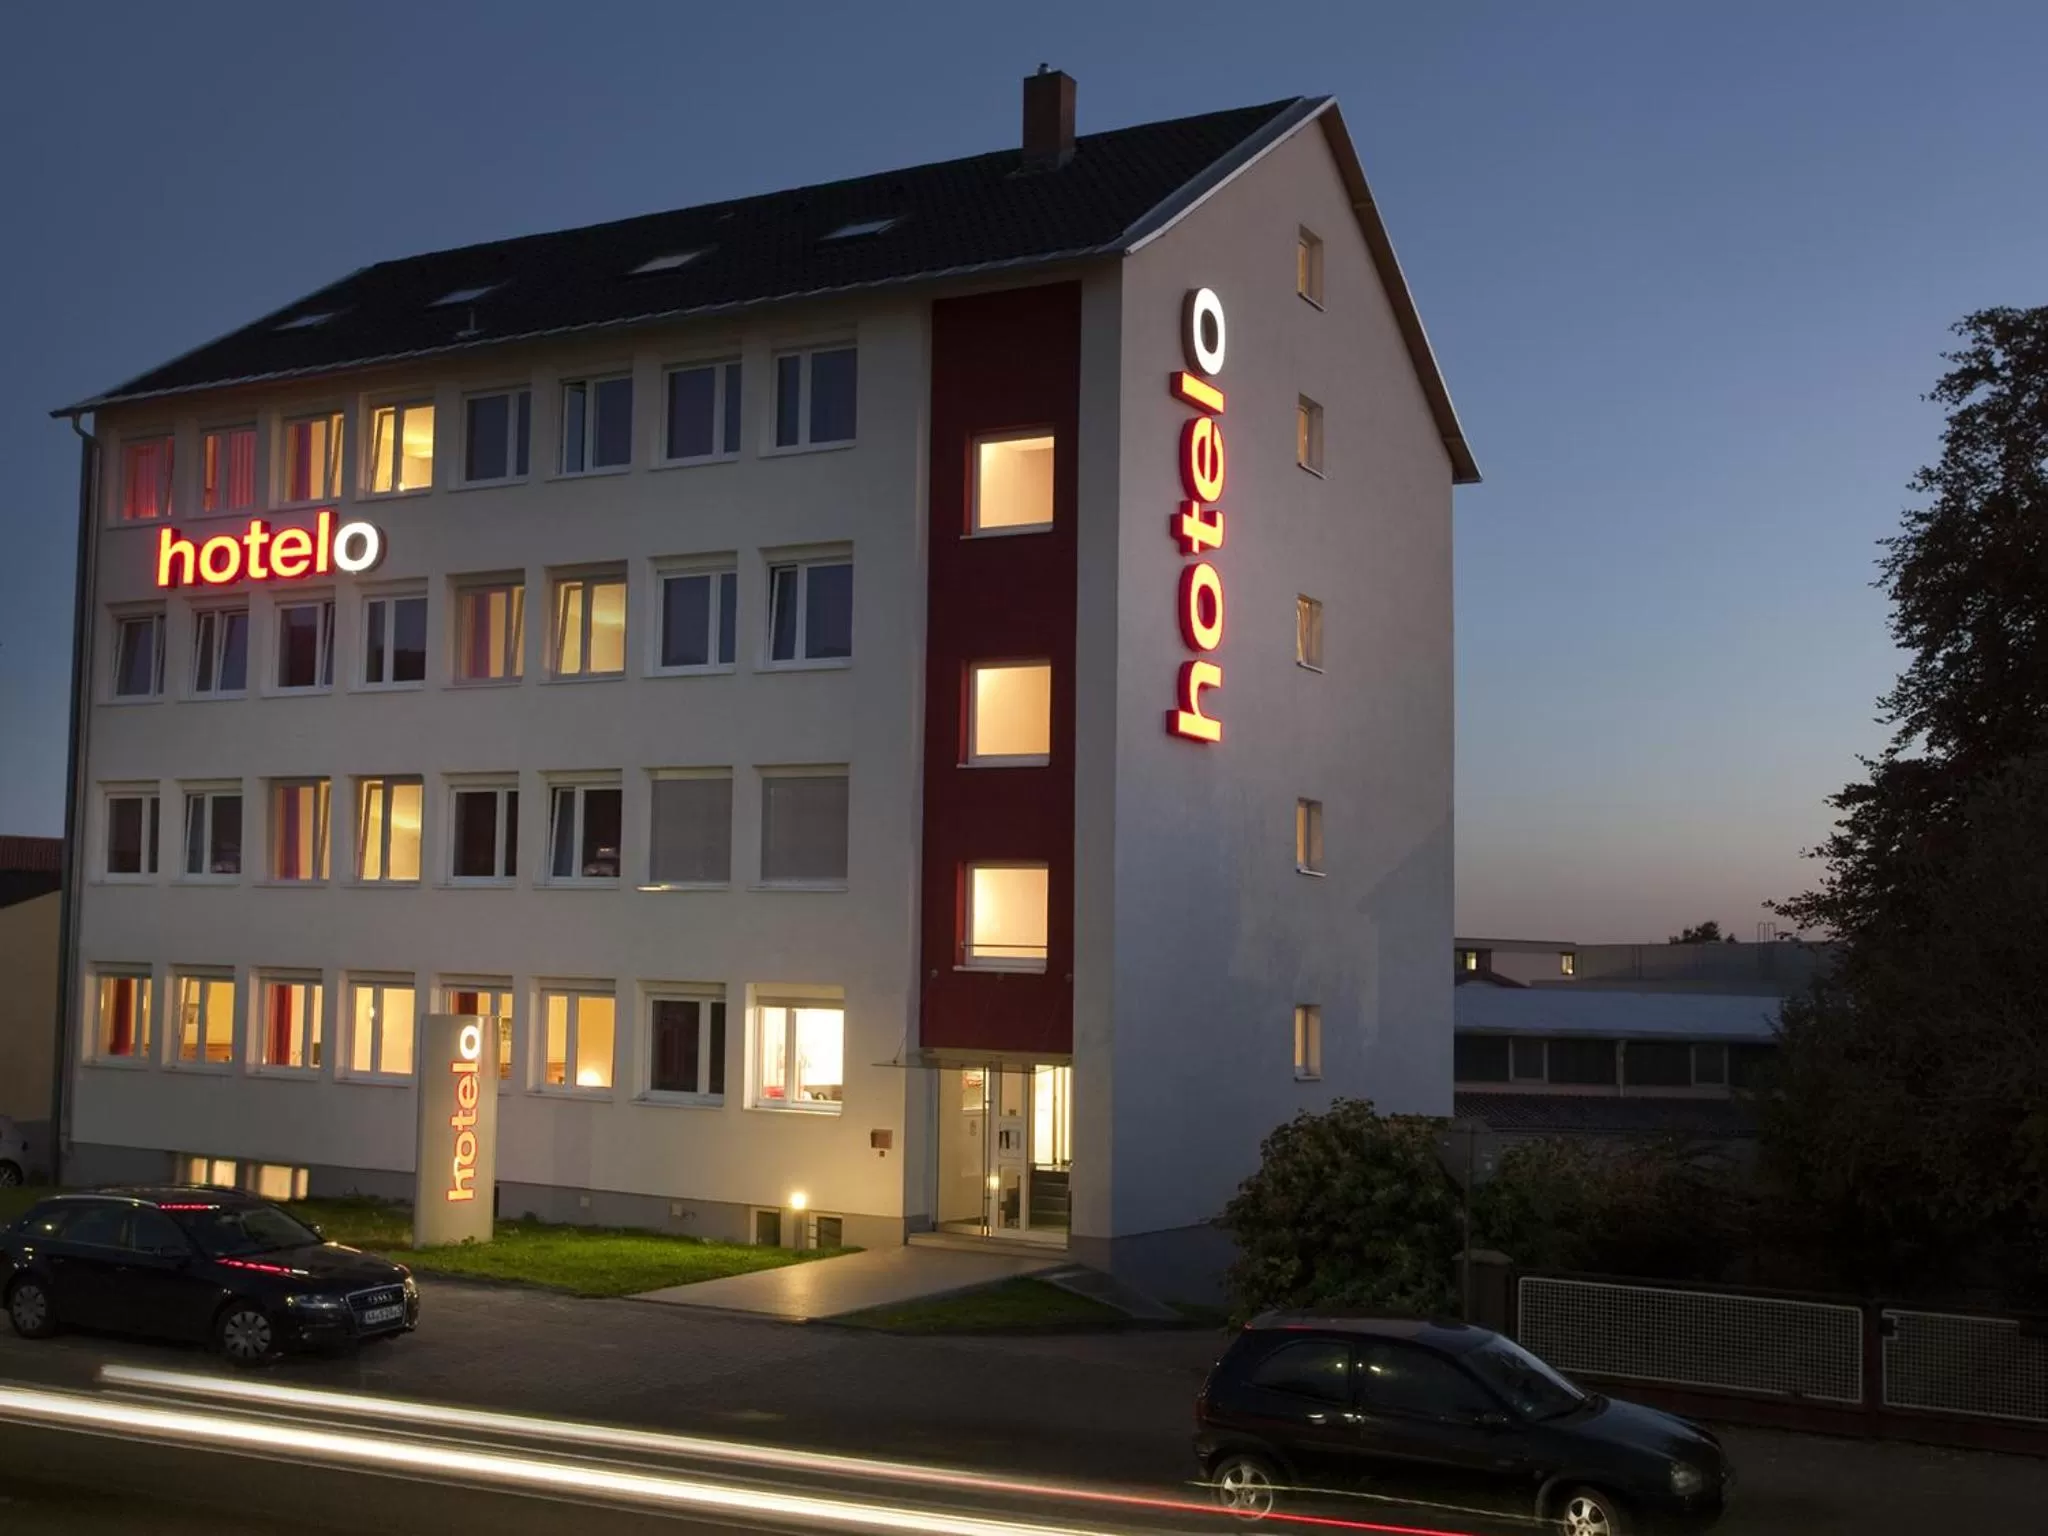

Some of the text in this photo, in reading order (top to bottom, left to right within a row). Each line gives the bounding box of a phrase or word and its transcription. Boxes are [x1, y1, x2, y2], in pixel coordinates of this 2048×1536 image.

[157, 510, 381, 587] hotelo
[1173, 287, 1226, 742] hotelo
[447, 1024, 481, 1201] hotelo
